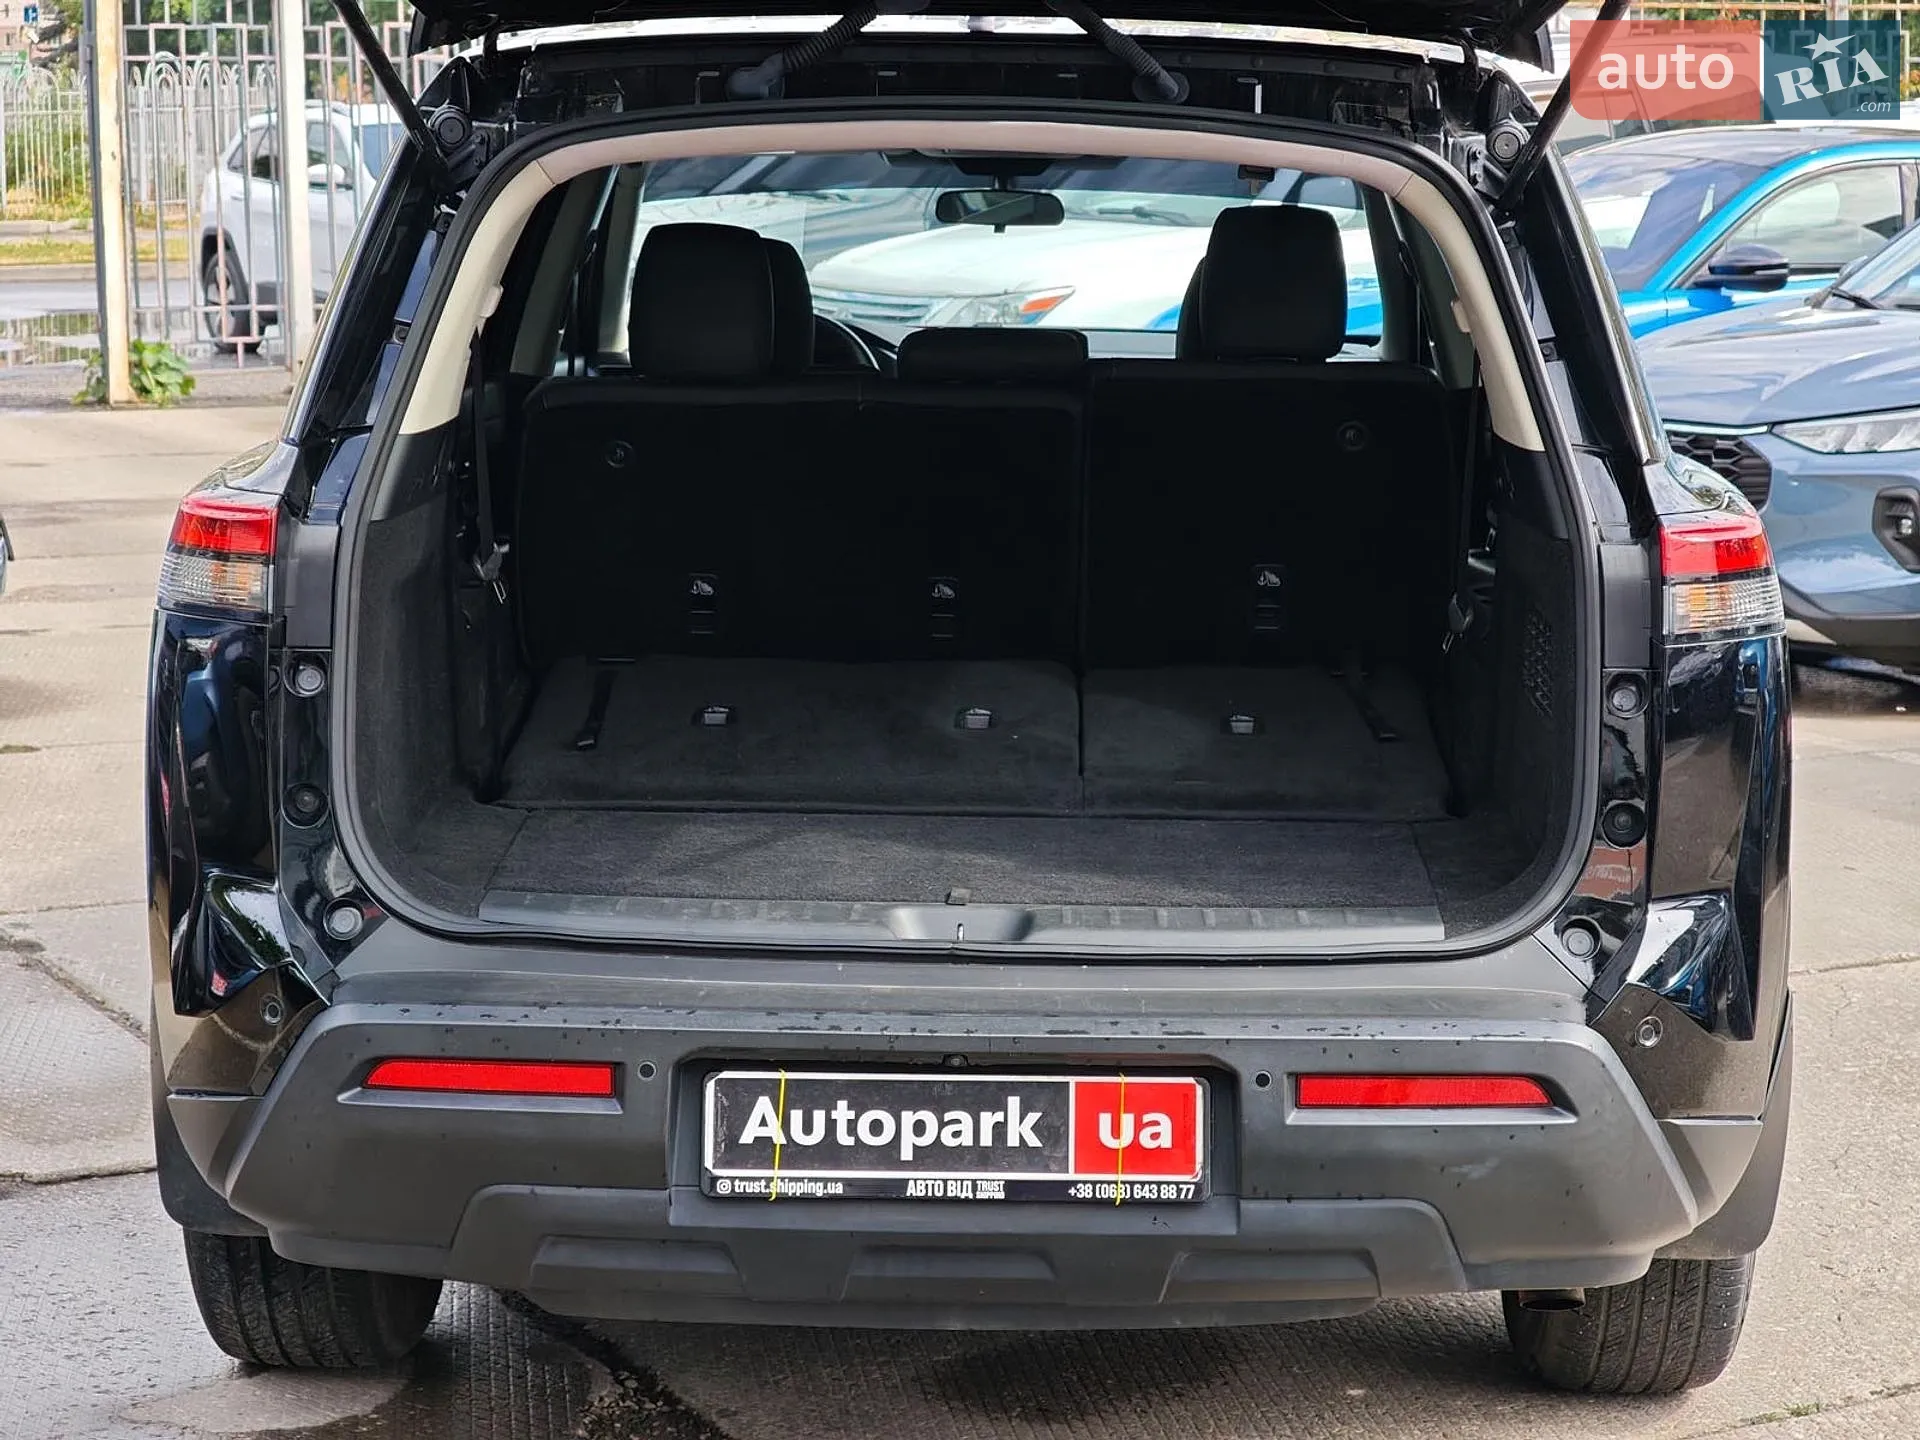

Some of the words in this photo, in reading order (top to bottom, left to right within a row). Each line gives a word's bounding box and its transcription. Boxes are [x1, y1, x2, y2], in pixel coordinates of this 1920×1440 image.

[738, 1095, 1043, 1161] Autopark
[1099, 1112, 1173, 1149] ua
[906, 1179, 944, 1197] АВТО
[946, 1179, 973, 1199] ВІД
[976, 1180, 1005, 1192] TRUST
[1067, 1183, 1093, 1199] +38
[1133, 1184, 1158, 1199] 643
[1160, 1184, 1177, 1199] 88
[1179, 1184, 1195, 1199] 77
